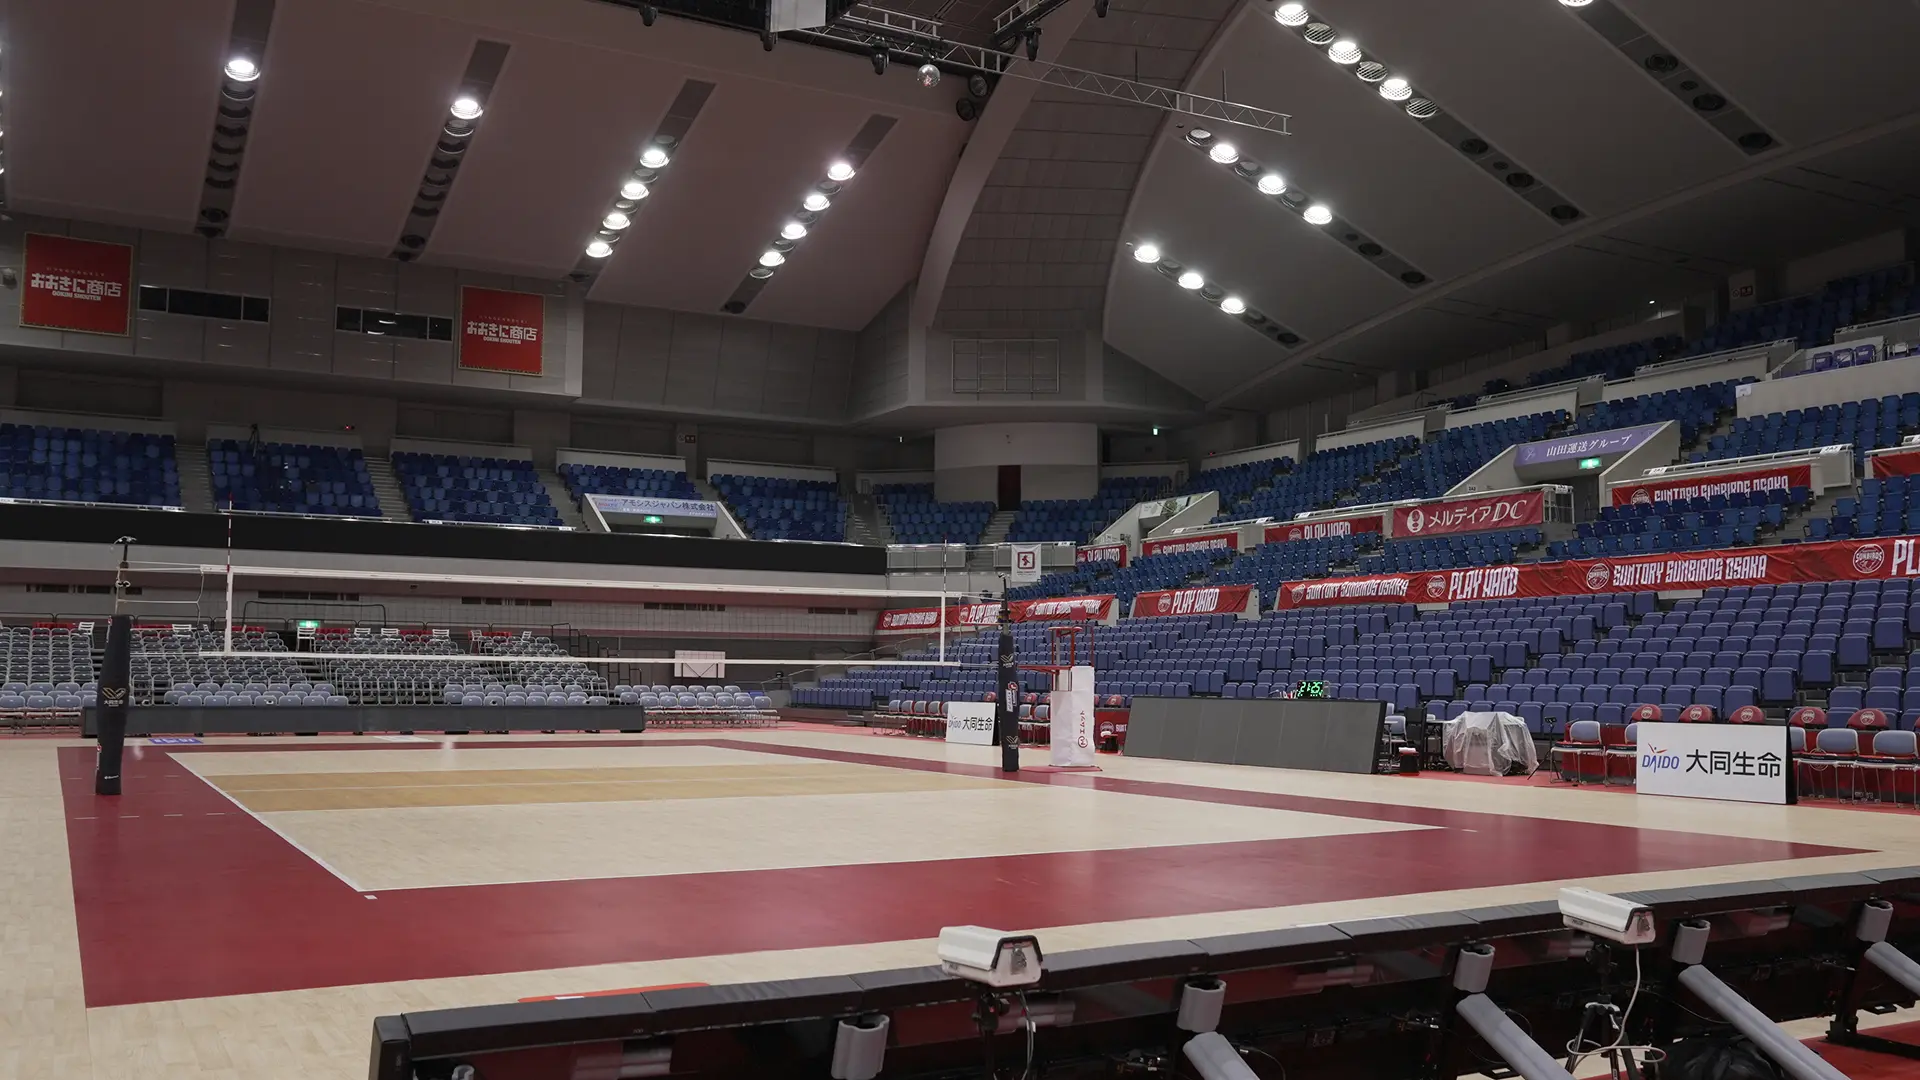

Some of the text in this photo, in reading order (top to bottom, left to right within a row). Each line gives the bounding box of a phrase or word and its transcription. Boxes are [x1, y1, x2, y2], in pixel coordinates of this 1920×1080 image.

[31, 273, 122, 297] おおきに商店
[467, 321, 538, 341] おおきに商店
[1546, 434, 1633, 457] 山田運送グループ
[1428, 500, 1527, 528] メルディアDC
[1612, 555, 1768, 586] SUNTORY SUNBIRDS OSAKA
[1891, 538, 1920, 576] PL
[1448, 566, 1519, 600] PLAY HARD
[1171, 588, 1220, 614] PLAY HARD
[962, 717, 993, 731] 大同生命
[1641, 749, 1782, 778] DAIDO 大同生命
